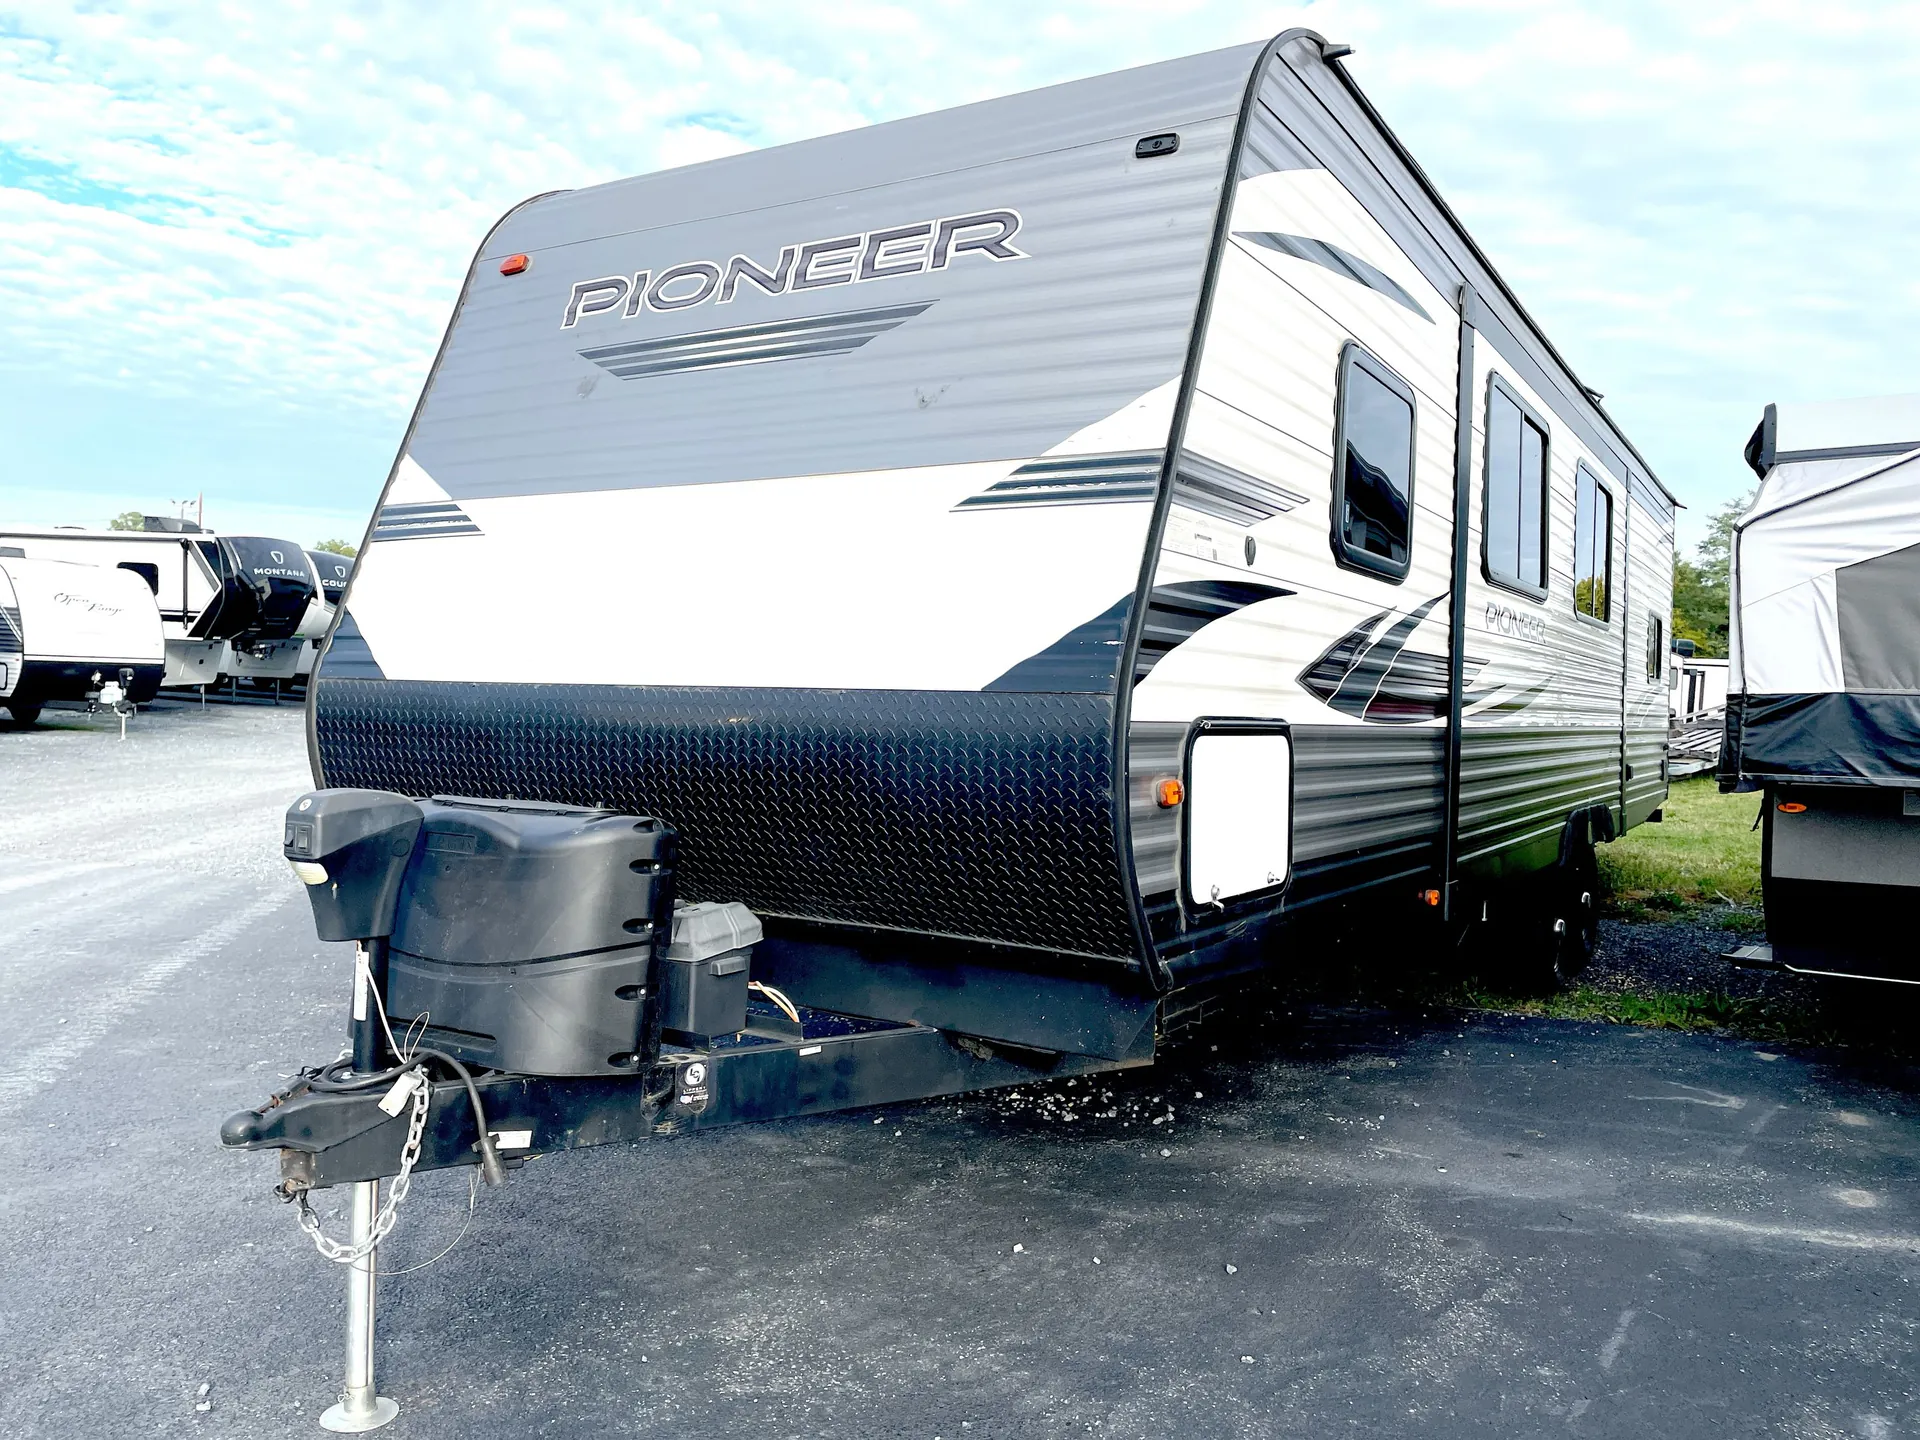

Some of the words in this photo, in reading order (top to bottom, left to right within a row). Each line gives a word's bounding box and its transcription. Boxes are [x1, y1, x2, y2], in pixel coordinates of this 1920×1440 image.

[560, 207, 1032, 330] PIONEER
[253, 567, 305, 577] MONTANA
[1485, 601, 1547, 644] PIONEER
